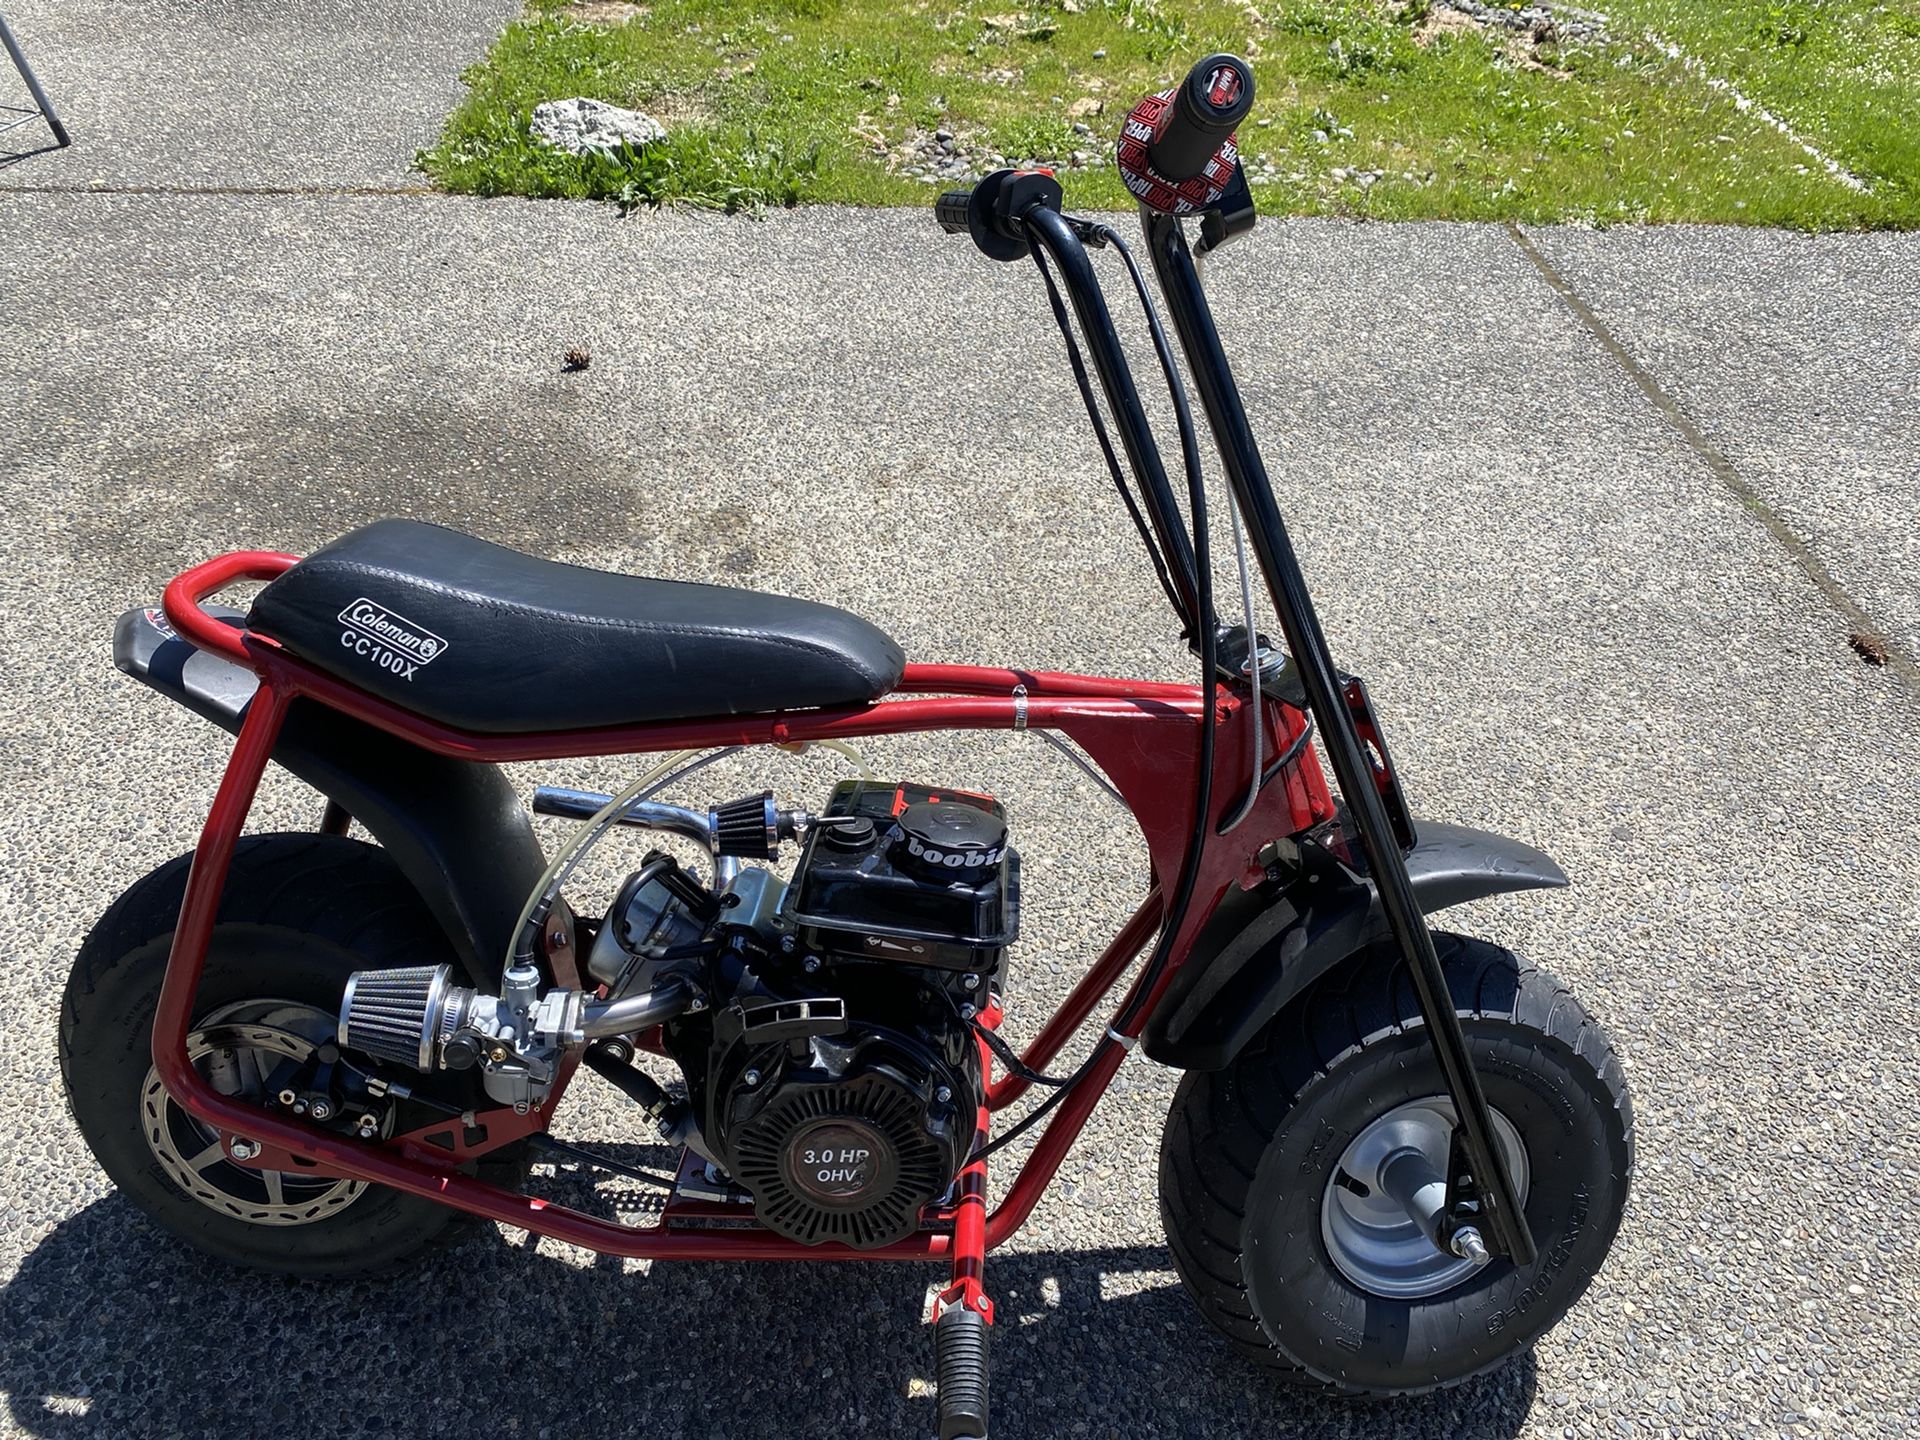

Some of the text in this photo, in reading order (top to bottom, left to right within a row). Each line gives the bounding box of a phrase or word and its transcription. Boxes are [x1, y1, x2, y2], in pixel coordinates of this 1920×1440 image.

[351, 604, 422, 650] Coleman
[340, 630, 419, 682] CC100X
[803, 1149, 834, 1164] 3.0
[817, 1169, 857, 1182] OHV
